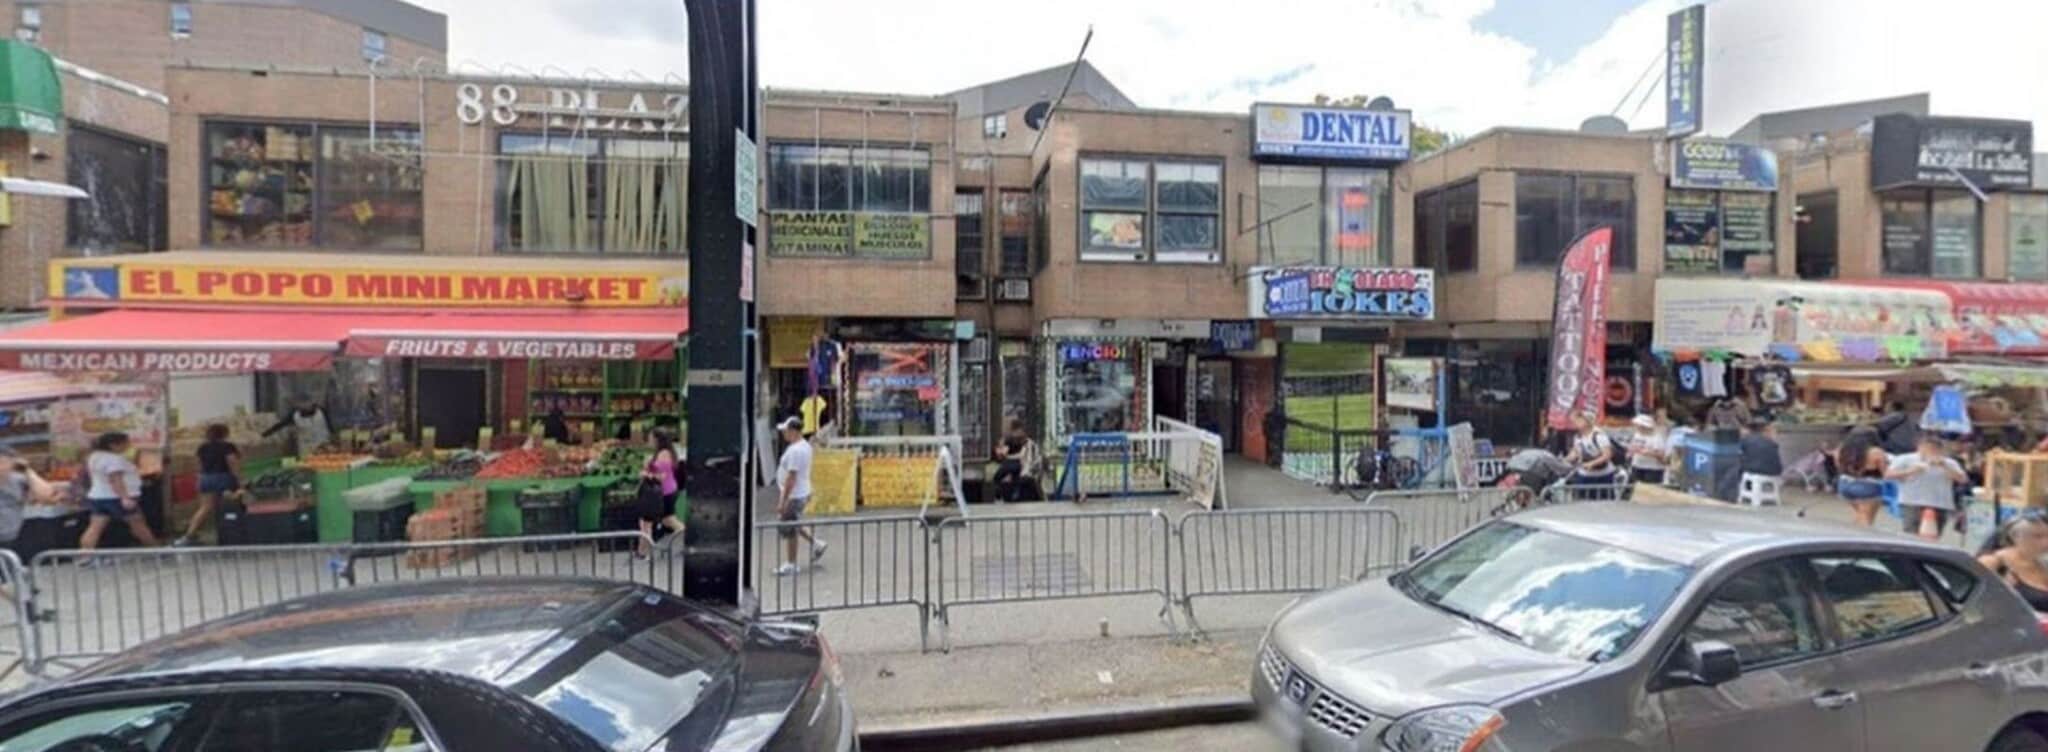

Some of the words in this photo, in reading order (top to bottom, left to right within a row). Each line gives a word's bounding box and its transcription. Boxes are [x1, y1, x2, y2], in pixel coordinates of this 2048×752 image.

[456, 83, 518, 124] 88
[551, 87, 688, 131] PLAZ
[1301, 111, 1402, 145] DENTAL
[774, 213, 848, 224] PLANTAS
[130, 270, 182, 294] EL
[197, 271, 333, 297] POPO
[346, 274, 451, 299] MINI
[462, 276, 647, 300] MARKET
[1311, 290, 1431, 315] OKES
[386, 340, 467, 356] FRIUTS
[471, 341, 489, 357] &
[497, 341, 636, 358] VEGETABLES
[20, 352, 138, 369] MEXICAN
[143, 352, 271, 369] PRODUCTS
[1477, 461, 1508, 478] TATT
